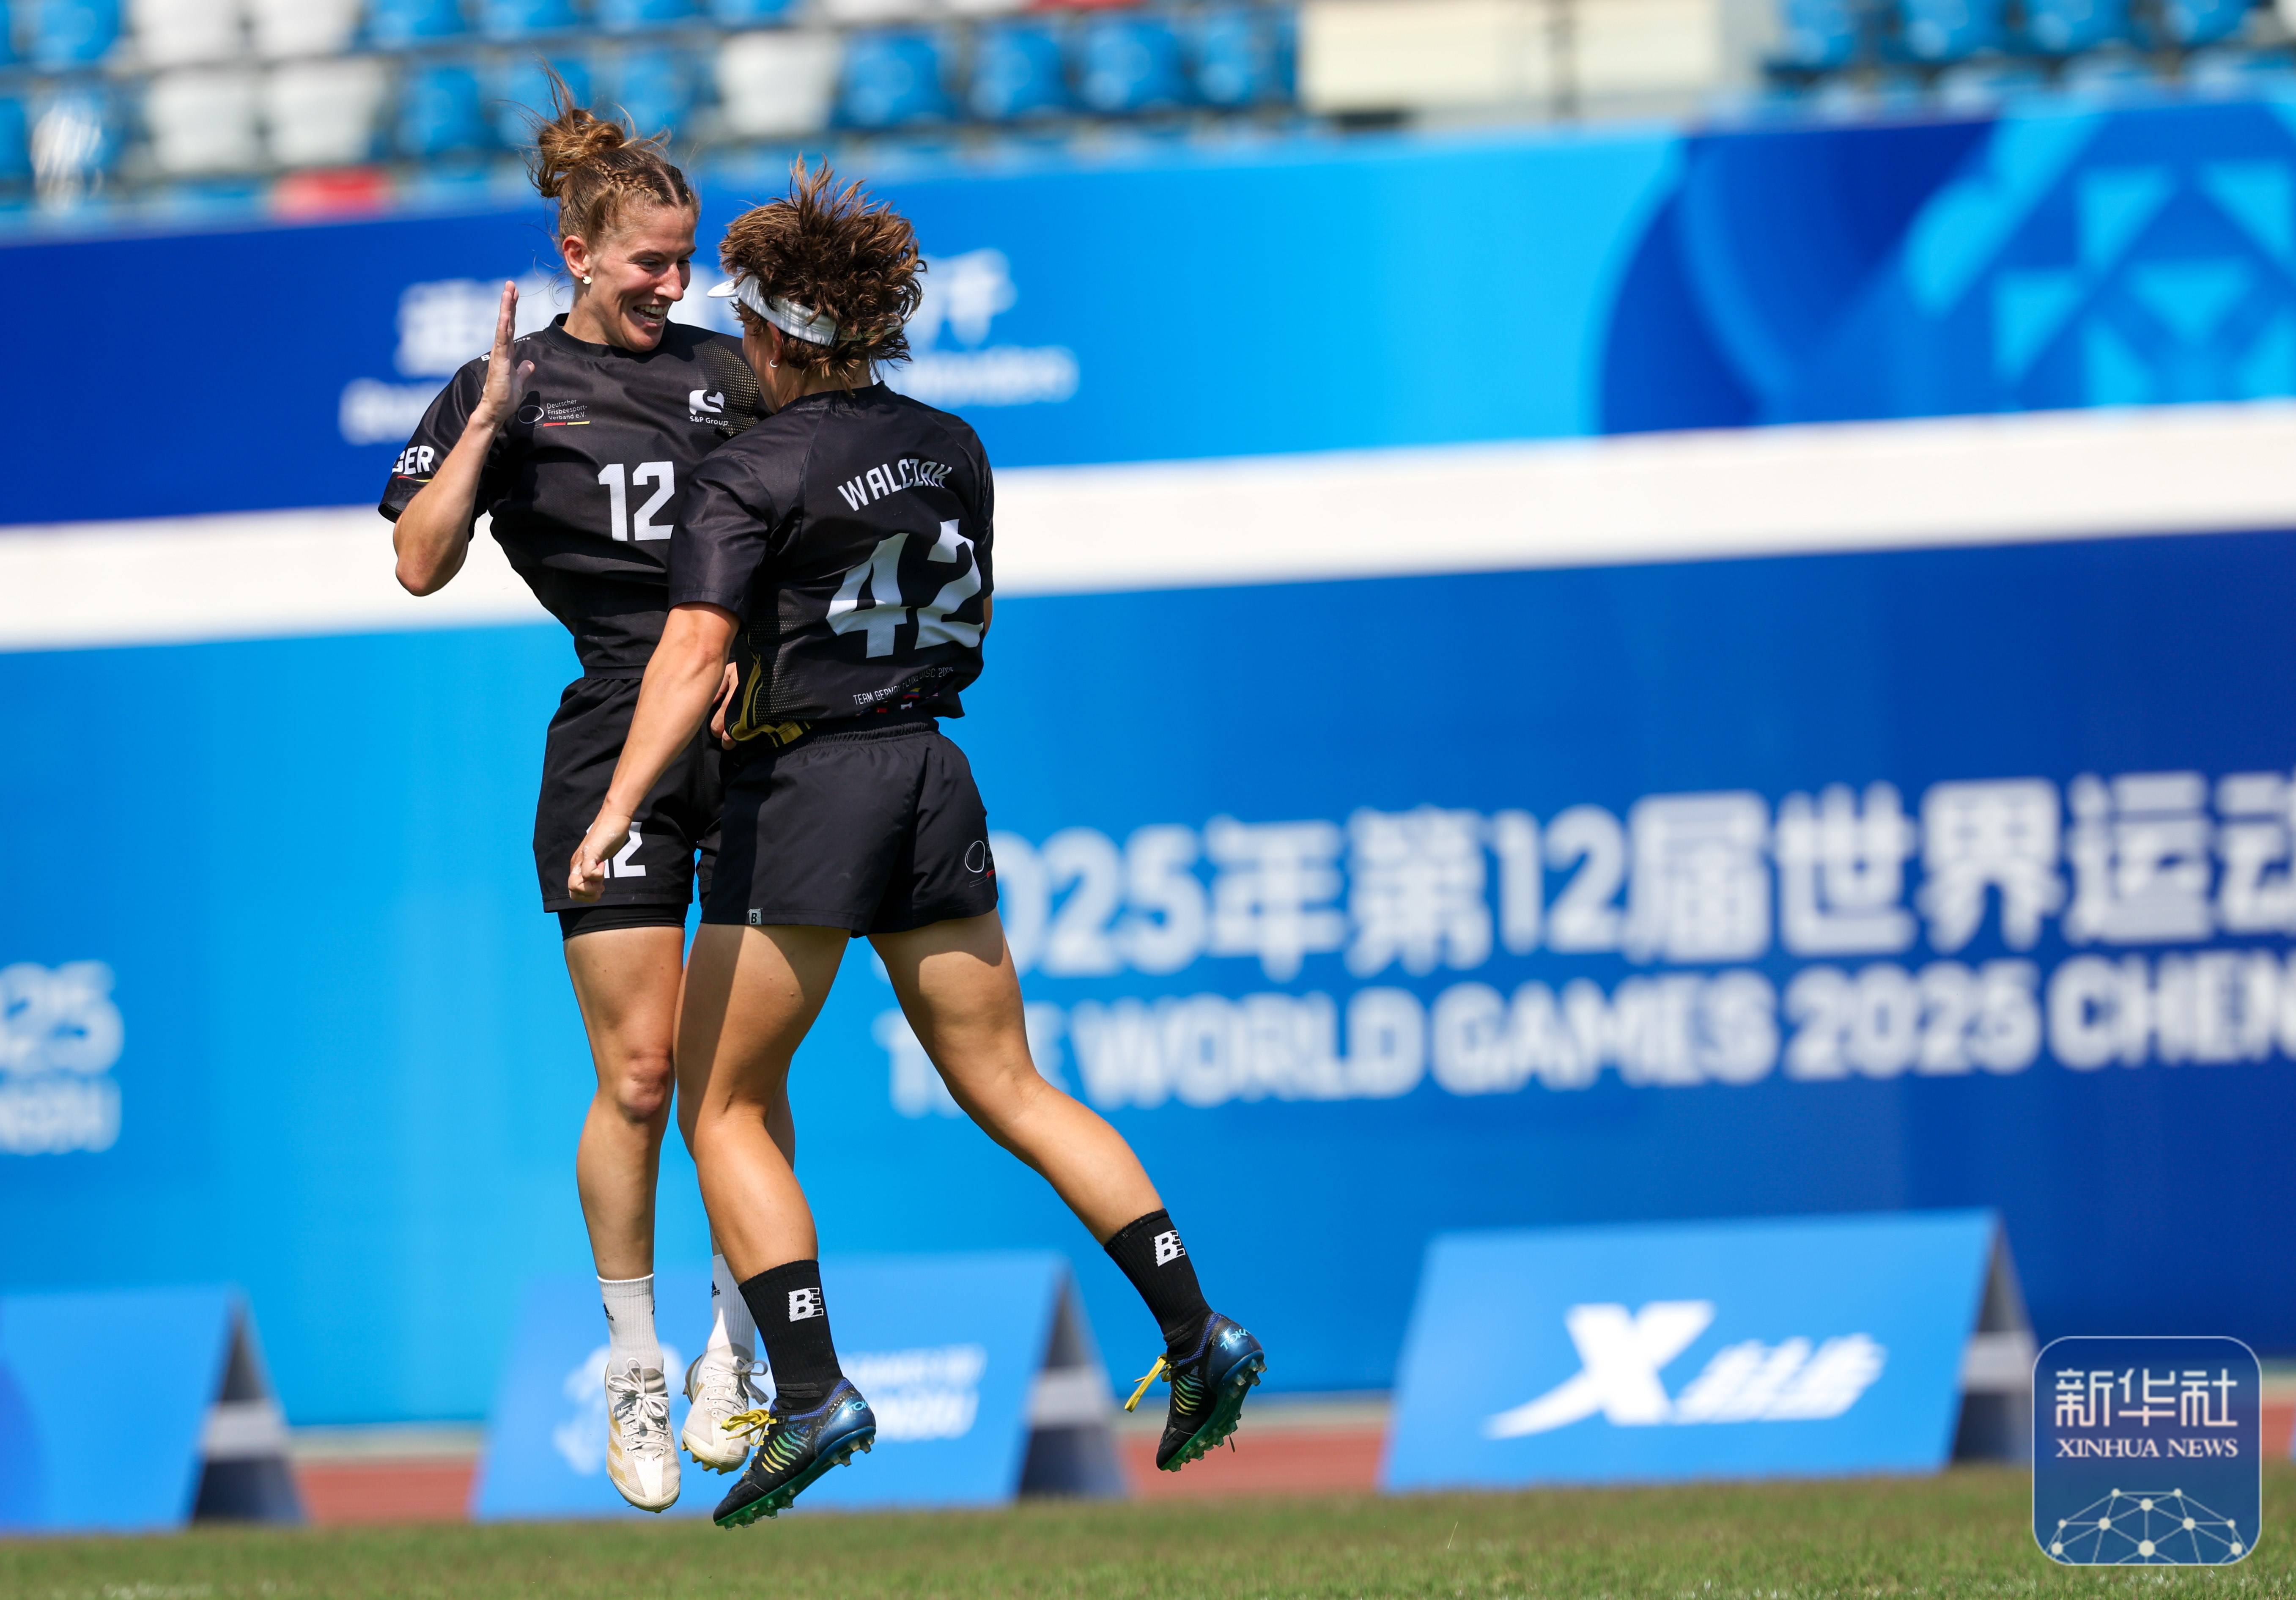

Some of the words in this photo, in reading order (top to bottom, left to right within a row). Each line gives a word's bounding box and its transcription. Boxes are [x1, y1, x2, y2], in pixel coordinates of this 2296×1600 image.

[547, 399, 577, 409] Deutscher
[548, 405, 587, 415] Frisbeesport-
[705, 417, 728, 427] Group
[392, 445, 435, 475] GER
[598, 461, 675, 541] 12
[837, 458, 952, 511] WALCZAK
[826, 519, 984, 659] 42
[853, 692, 874, 705] TEAM
[586, 821, 647, 879] 2
[1432, 968, 1779, 1098] GAMES
[1786, 959, 2042, 1081] 2025
